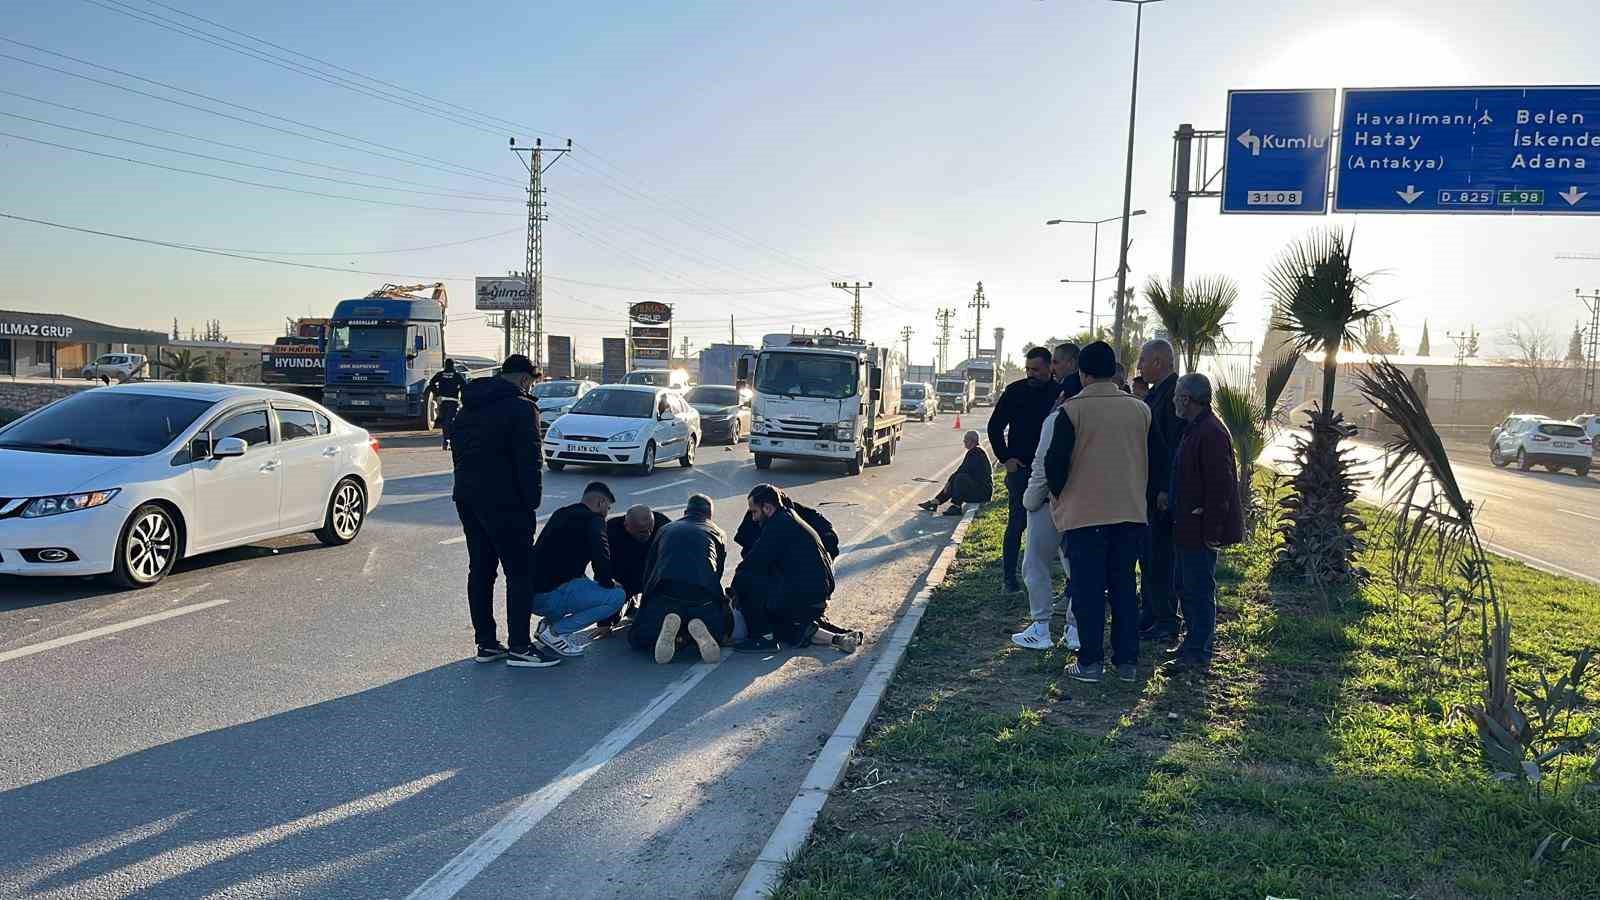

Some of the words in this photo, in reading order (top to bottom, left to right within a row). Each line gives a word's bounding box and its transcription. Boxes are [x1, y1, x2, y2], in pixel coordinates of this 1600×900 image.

[1516, 109, 1584, 124] Belen
[1263, 133, 1325, 149] Kumlu
[1355, 131, 1421, 150] Hatay
[1348, 155, 1444, 172] (Antakya)
[1511, 153, 1586, 169] Adana
[1252, 192, 1297, 203] 31.08
[1441, 192, 1489, 203] D.825
[1502, 192, 1539, 203] E.98
[41, 325, 73, 337] GRUP
